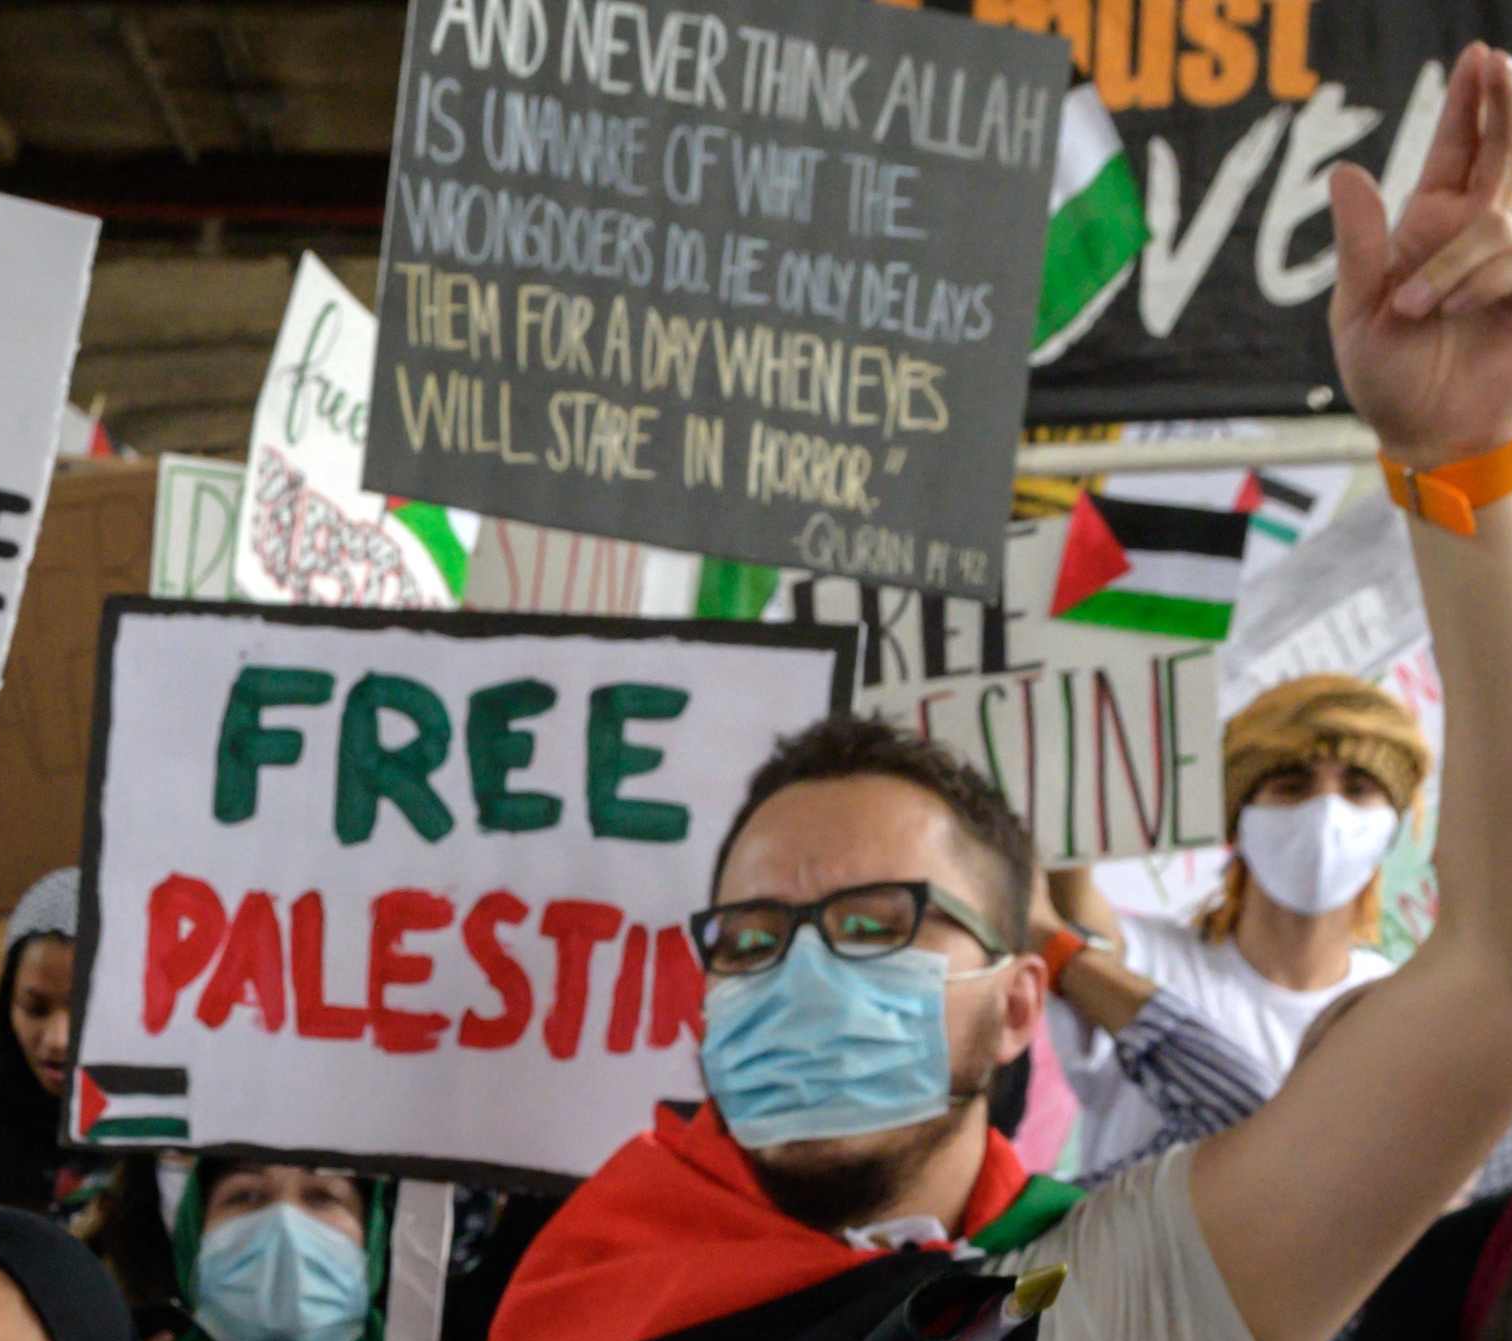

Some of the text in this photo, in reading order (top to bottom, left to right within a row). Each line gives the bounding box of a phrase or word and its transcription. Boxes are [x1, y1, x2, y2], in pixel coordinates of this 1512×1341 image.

[430, 0, 1048, 168] AND NEVER THINK ALLAH
[966, 0, 1322, 111] ust
[416, 71, 466, 166] IS
[664, 122, 727, 205] OF
[730, 135, 827, 224] WHAT
[843, 152, 930, 242] THE
[398, 171, 653, 285] WRONGDOERS
[719, 233, 773, 308] HE
[777, 250, 860, 325] ONLY
[864, 260, 994, 344] DELAYS
[394, 260, 952, 438] THEM FOR A DAY WHEN EYES
[395, 363, 538, 465] WILL
[546, 389, 661, 482] STARE
[683, 410, 724, 489] IN
[212, 662, 691, 848] FREE
[142, 872, 708, 1062] PALESTIN
